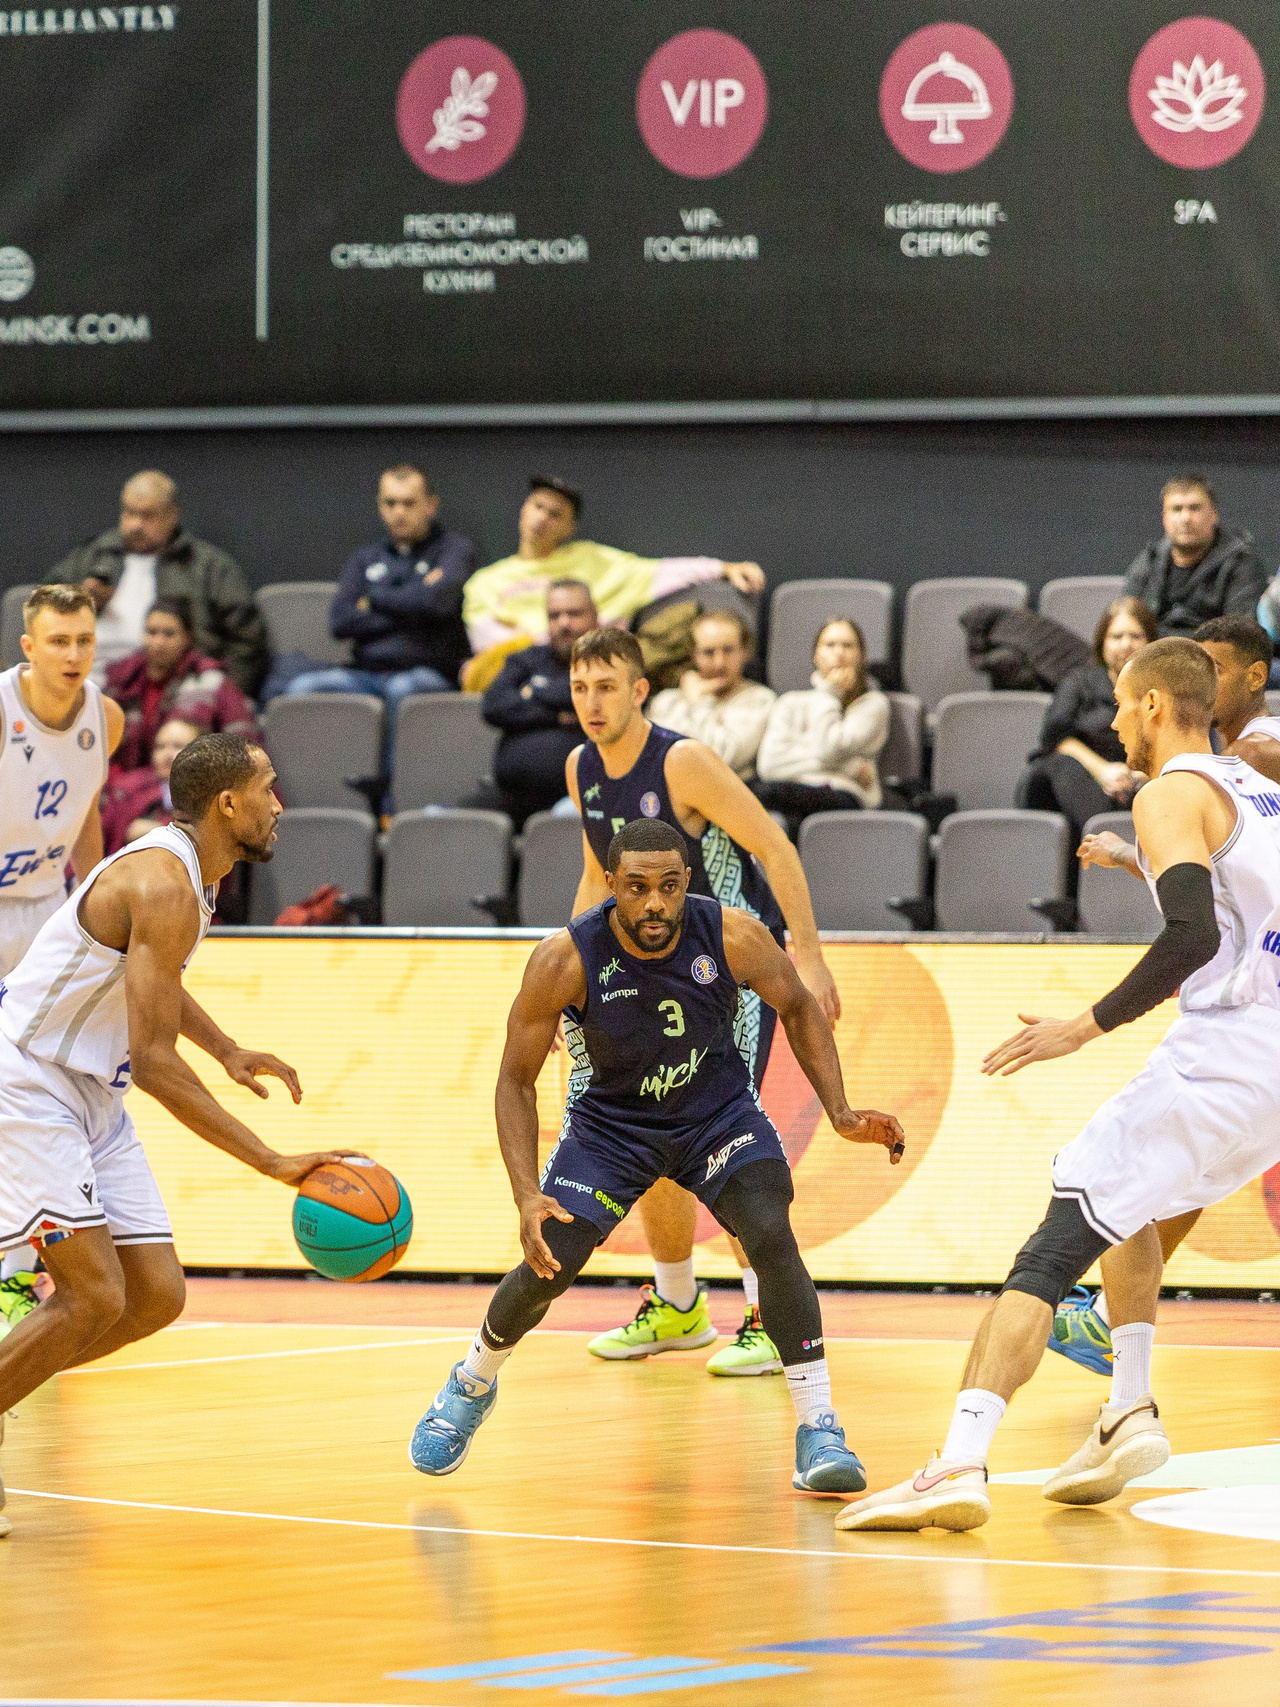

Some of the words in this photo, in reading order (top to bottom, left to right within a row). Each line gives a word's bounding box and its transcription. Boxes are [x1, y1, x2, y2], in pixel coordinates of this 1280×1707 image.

[661, 78, 746, 128] VIP
[1174, 199, 1219, 225] SPA
[403, 213, 516, 239] РЕСТОРАН
[644, 235, 760, 263] ГОСТИНАЯ
[900, 231, 991, 258] СЕРВИС
[34, 779, 68, 821] 12
[601, 988, 639, 1004] Kempa
[658, 999, 687, 1037] 3
[554, 1176, 594, 1195] Kempa
